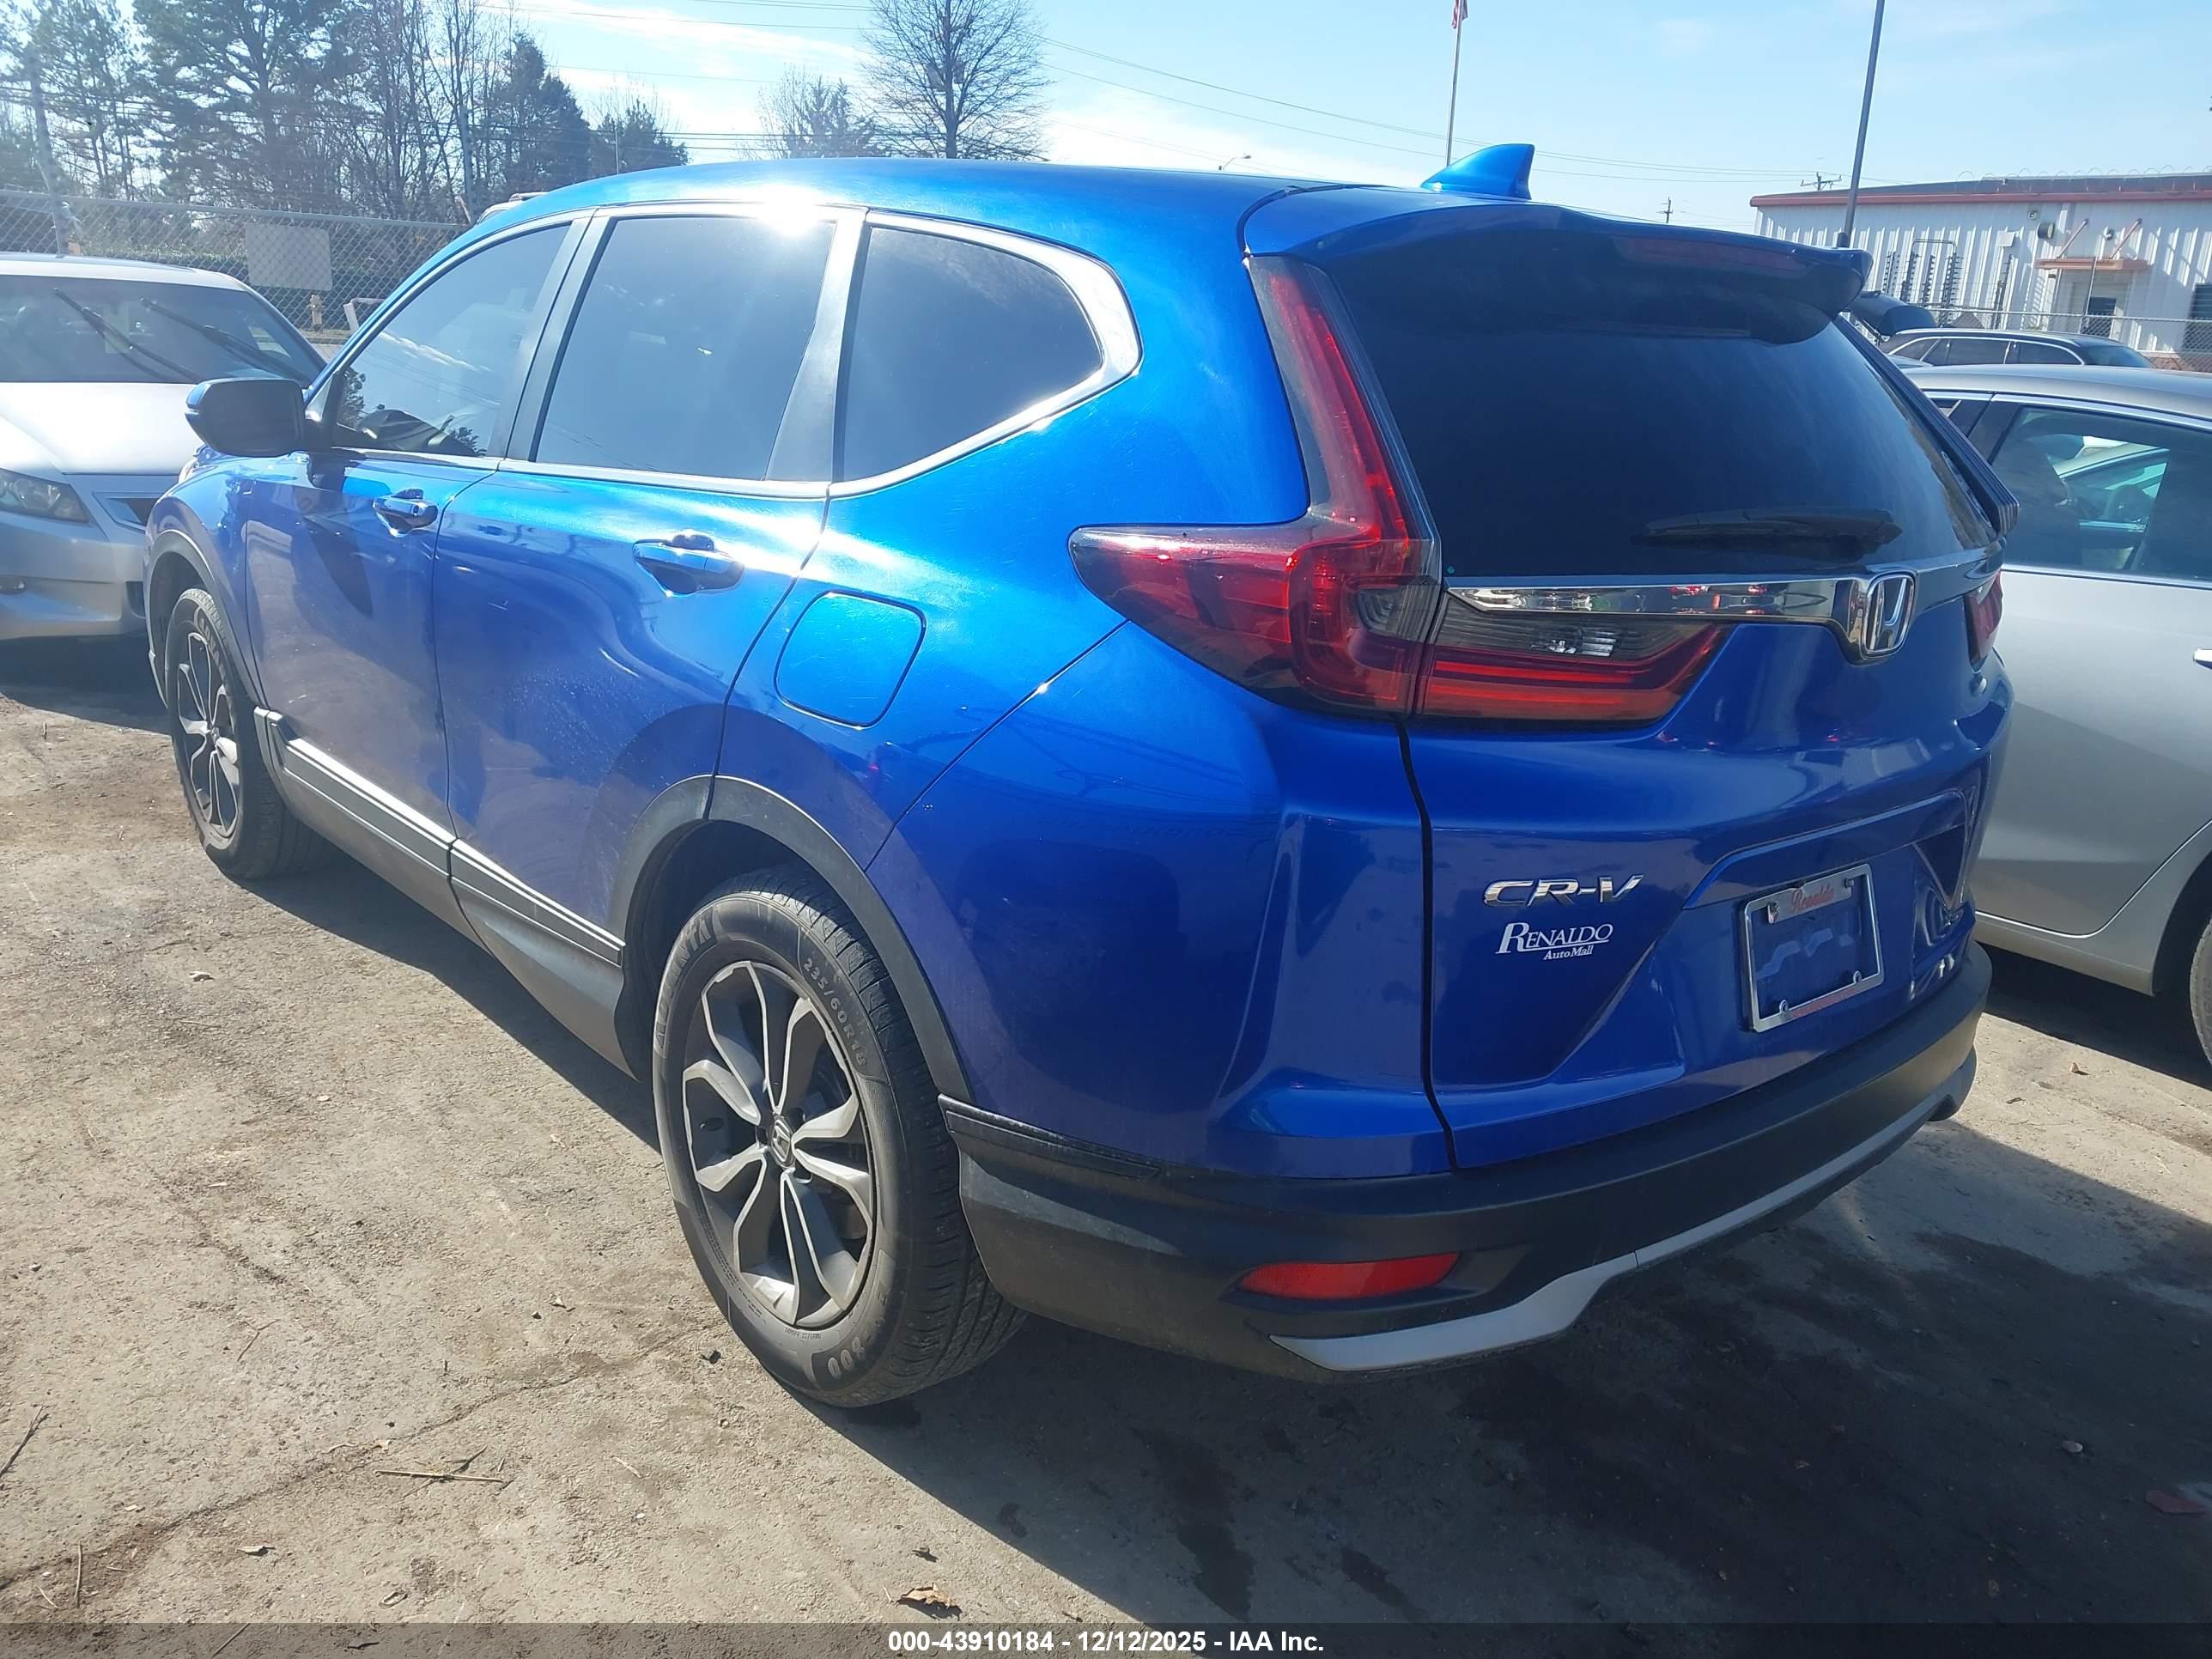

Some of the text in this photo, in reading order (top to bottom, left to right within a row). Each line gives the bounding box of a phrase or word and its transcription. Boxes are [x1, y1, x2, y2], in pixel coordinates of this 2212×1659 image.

[1484, 874, 1644, 907] CR-V
[1495, 922, 1613, 955] RENALDO
[803, 959, 867, 1066] 235/60R18
